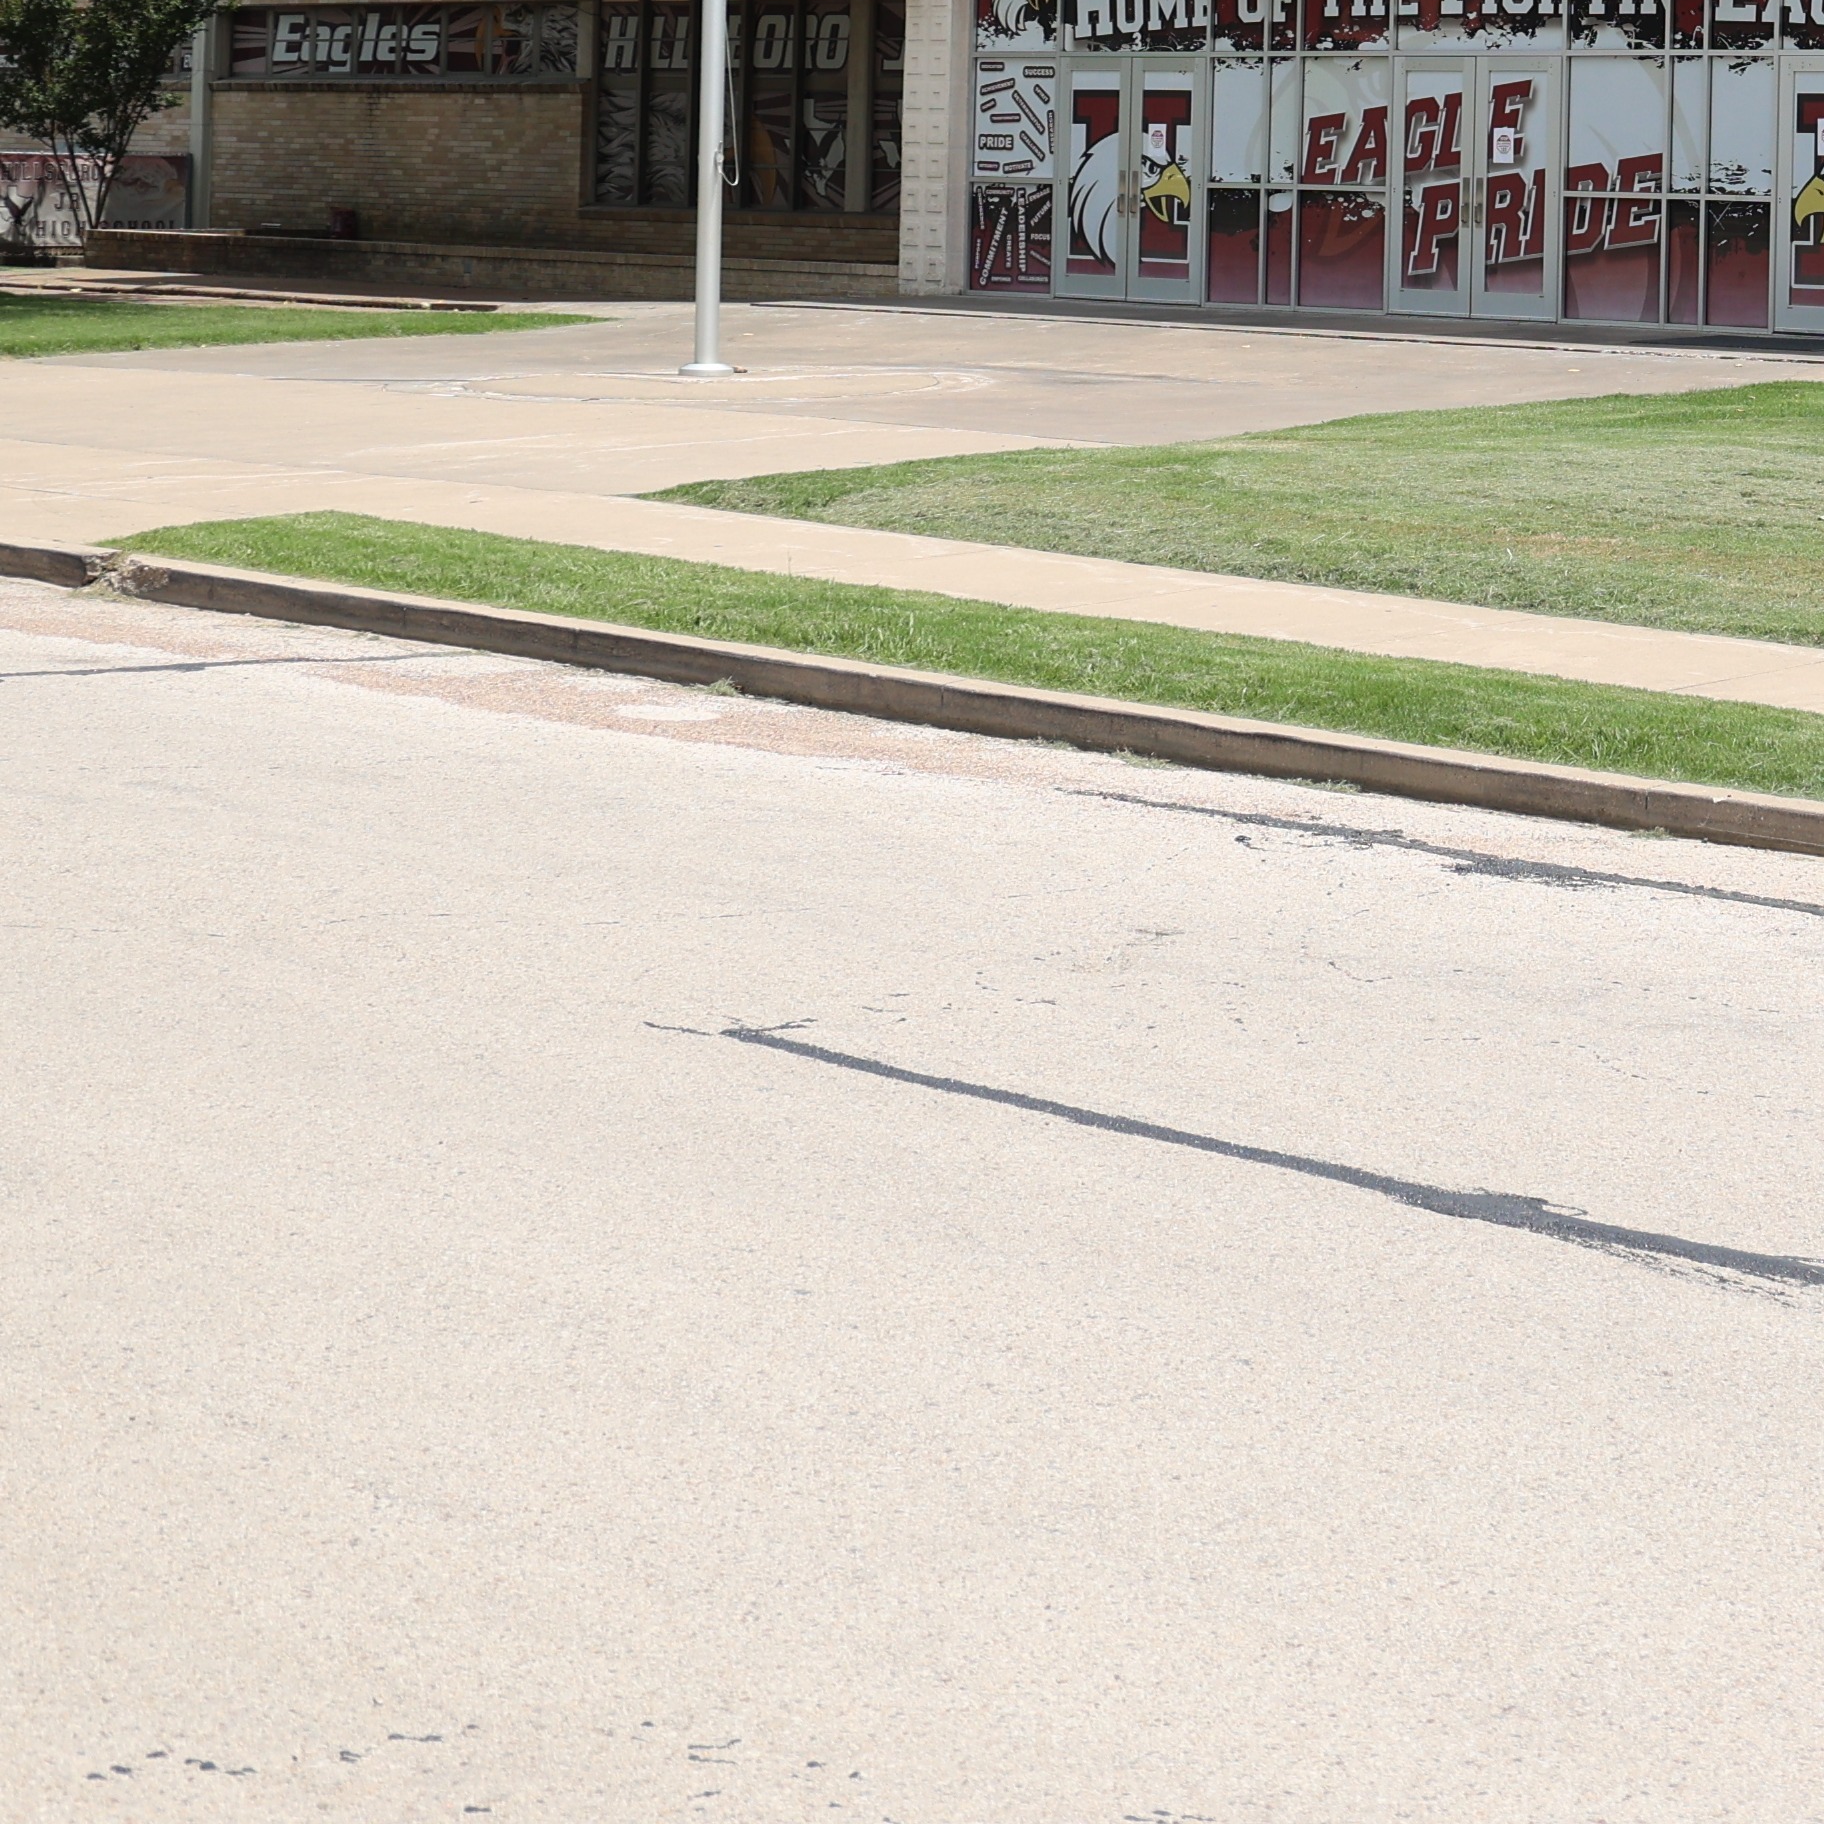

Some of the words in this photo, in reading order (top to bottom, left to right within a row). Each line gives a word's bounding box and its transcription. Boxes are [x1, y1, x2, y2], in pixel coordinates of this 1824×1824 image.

[272, 13, 440, 72] Eagles
[604, 15, 850, 68] HLLBORO
[1132, 32, 1143, 50] 3
[1025, 68, 1053, 76] SUCCESS
[979, 137, 1013, 148] PRIDE
[1303, 79, 1534, 184] EAGLE
[54, 192, 80, 211] JR
[1030, 200, 1052, 227] FUTURE
[1407, 152, 1663, 276] PRIDE
[979, 207, 1008, 286] COMMITMENT
[1017, 189, 1026, 272] LEADERSHIP
[1030, 233, 1051, 241] FOCUS
